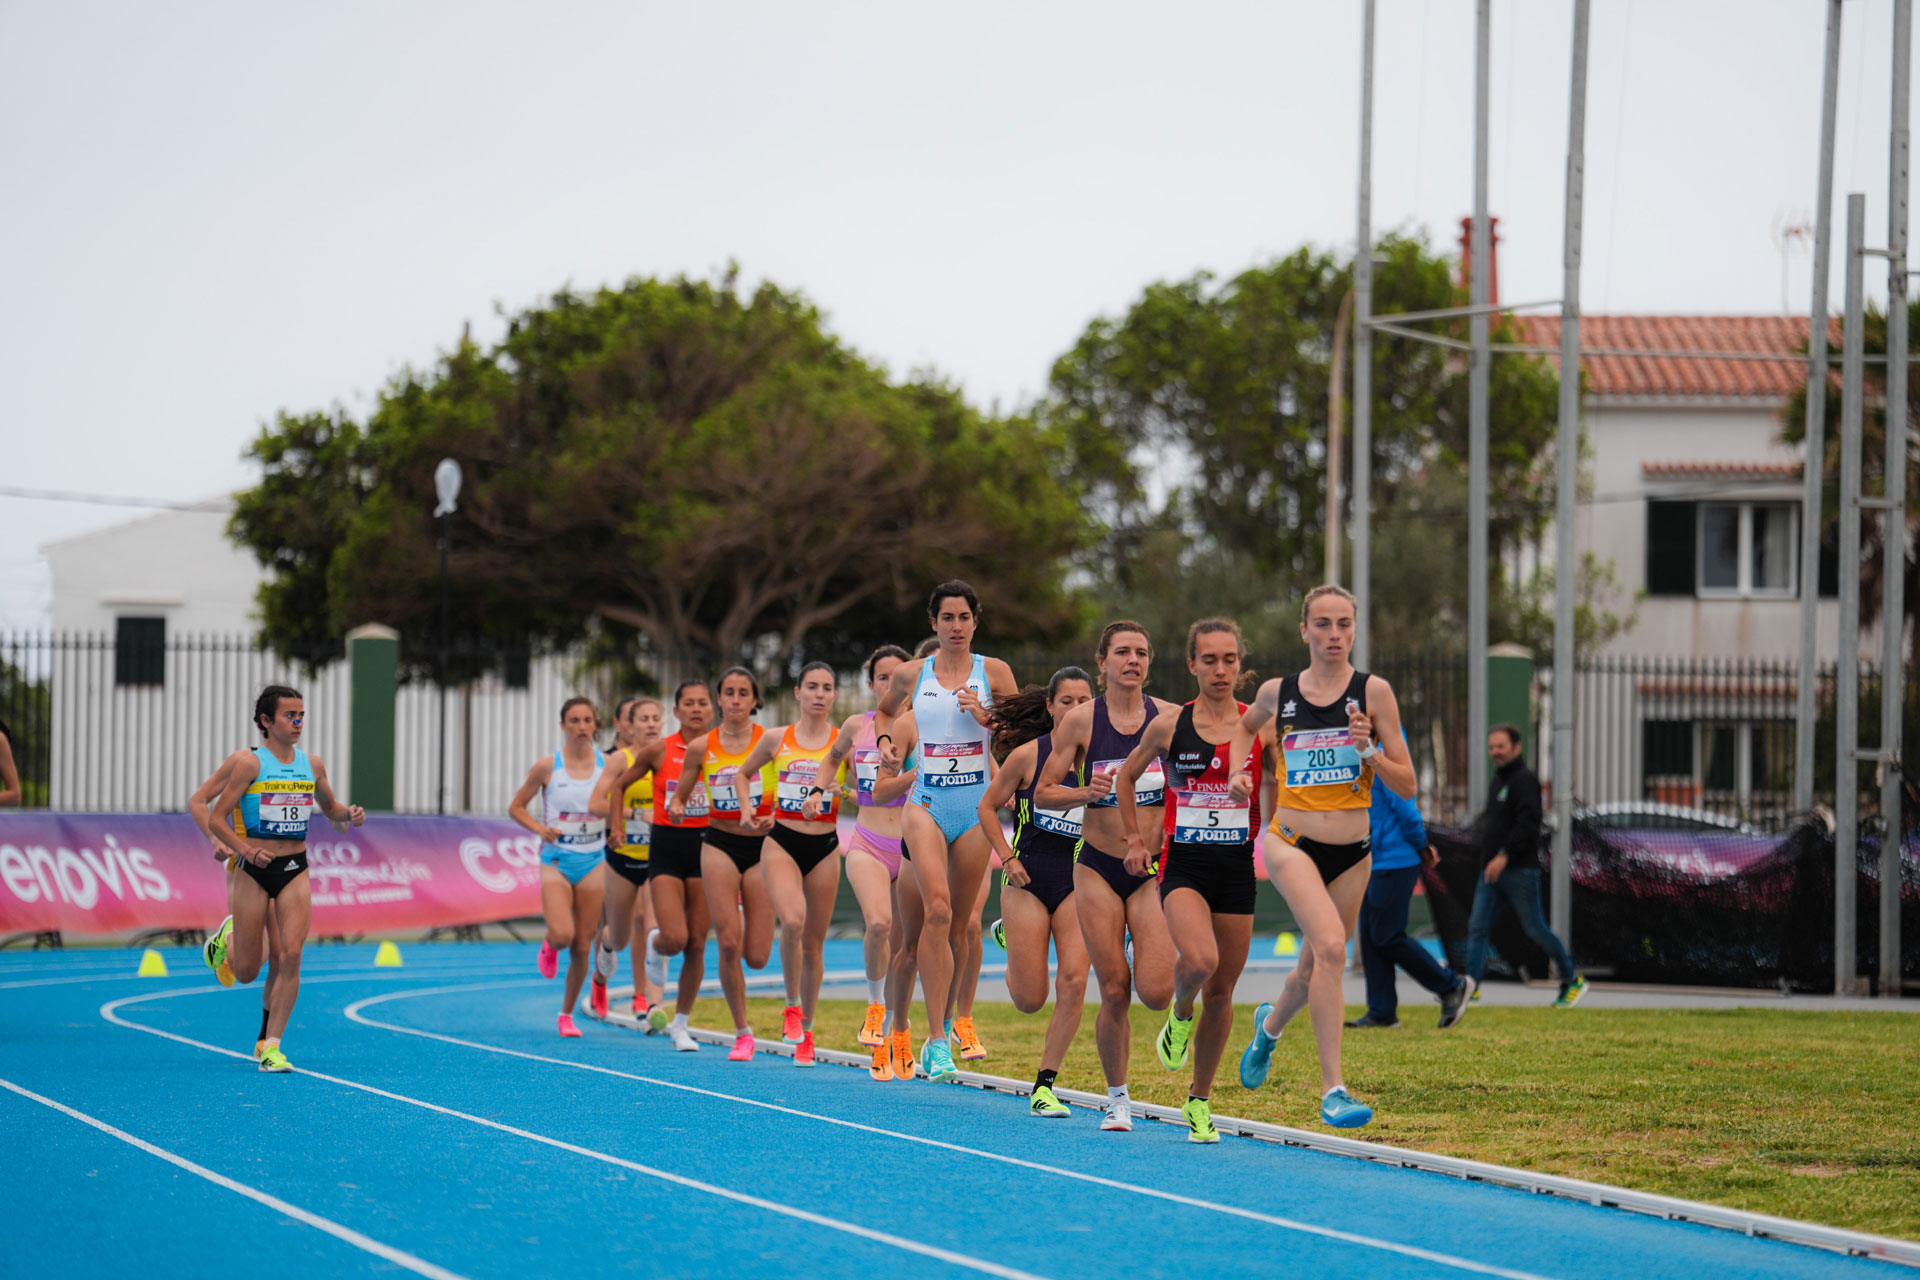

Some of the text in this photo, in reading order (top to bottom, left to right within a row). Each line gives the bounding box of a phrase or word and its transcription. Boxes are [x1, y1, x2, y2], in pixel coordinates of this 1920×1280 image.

[948, 757, 959, 773] 2
[1307, 748, 1336, 768] 203
[940, 774, 977, 787] Joma
[1306, 767, 1353, 785] Joma
[799, 786, 809, 799] 9
[281, 806, 299, 821] 18
[1208, 810, 1219, 827] 5
[277, 822, 307, 834] Joma
[579, 822, 588, 834] 4
[1047, 818, 1082, 836] Joma
[1196, 829, 1241, 842] Joma
[0, 833, 170, 910] enovis
